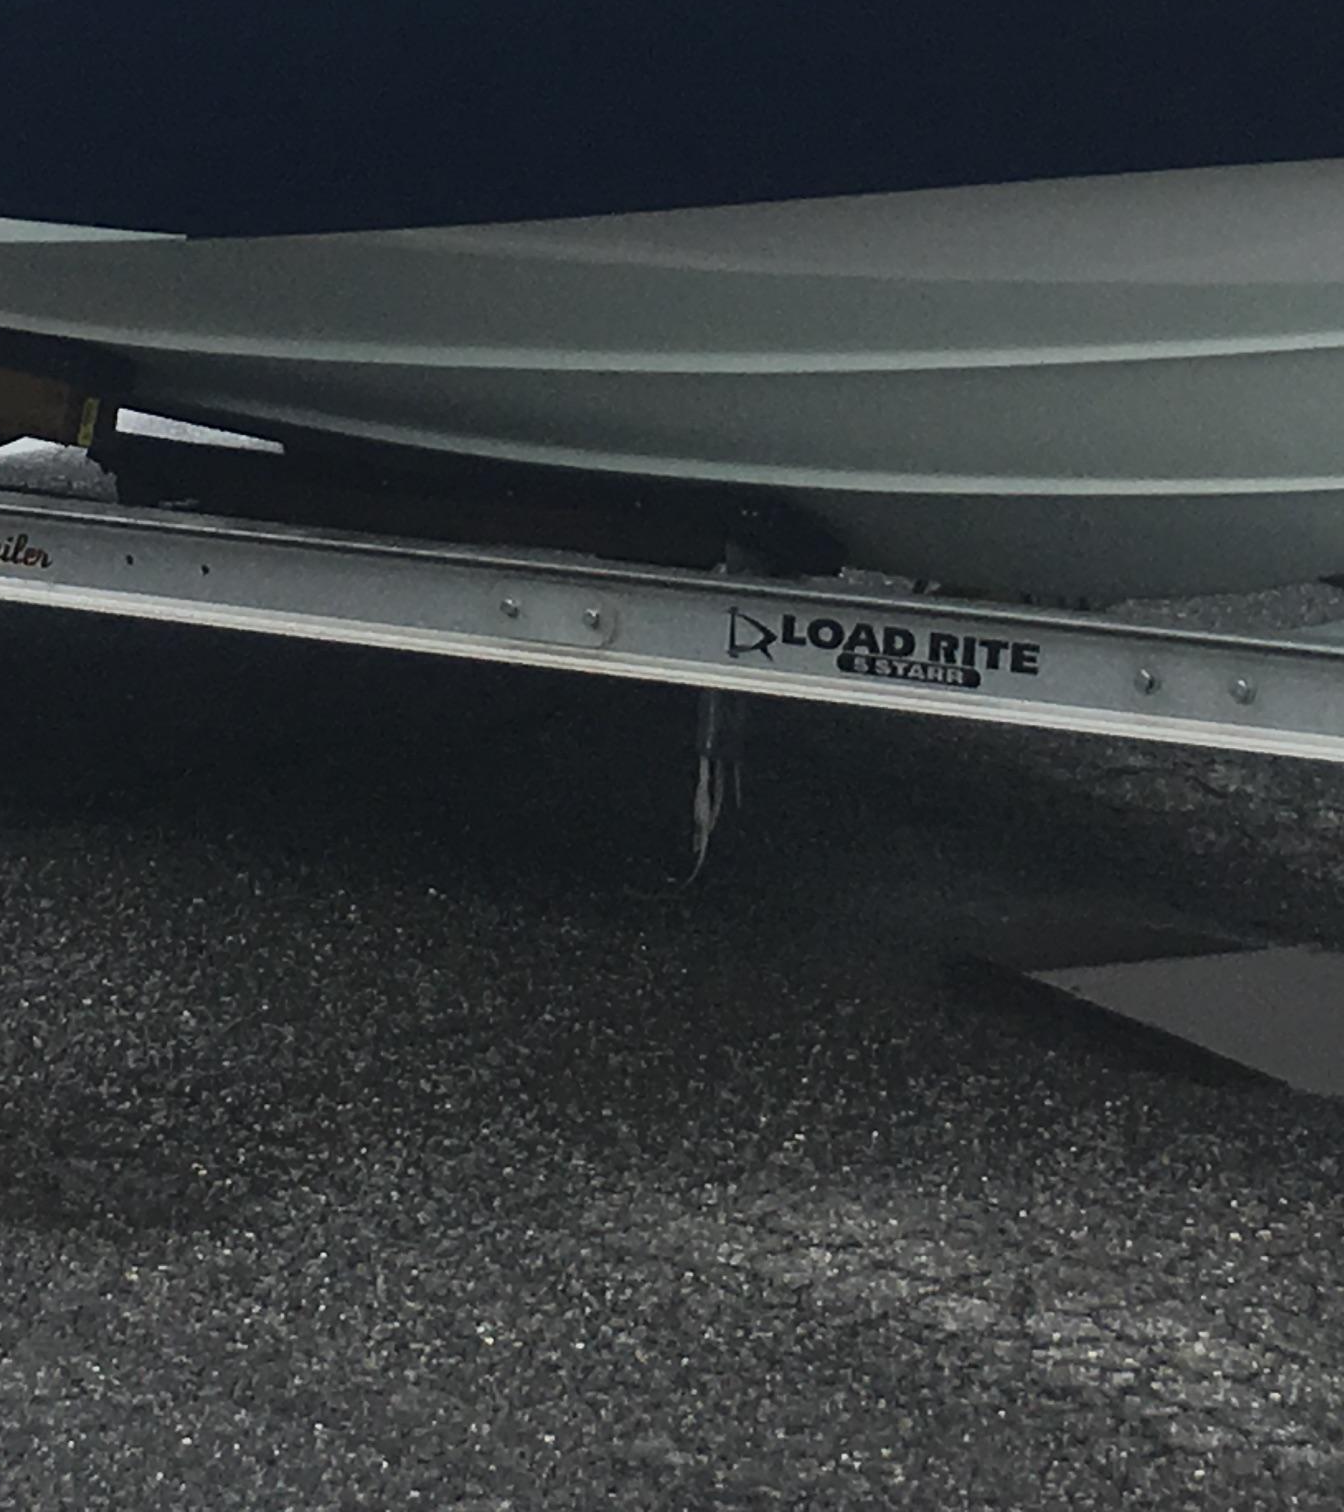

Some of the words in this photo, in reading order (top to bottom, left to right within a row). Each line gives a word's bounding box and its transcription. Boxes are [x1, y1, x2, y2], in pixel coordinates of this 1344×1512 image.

[781, 614, 916, 657] LOAD
[929, 632, 1041, 676] RITE
[874, 658, 964, 685] STARR
